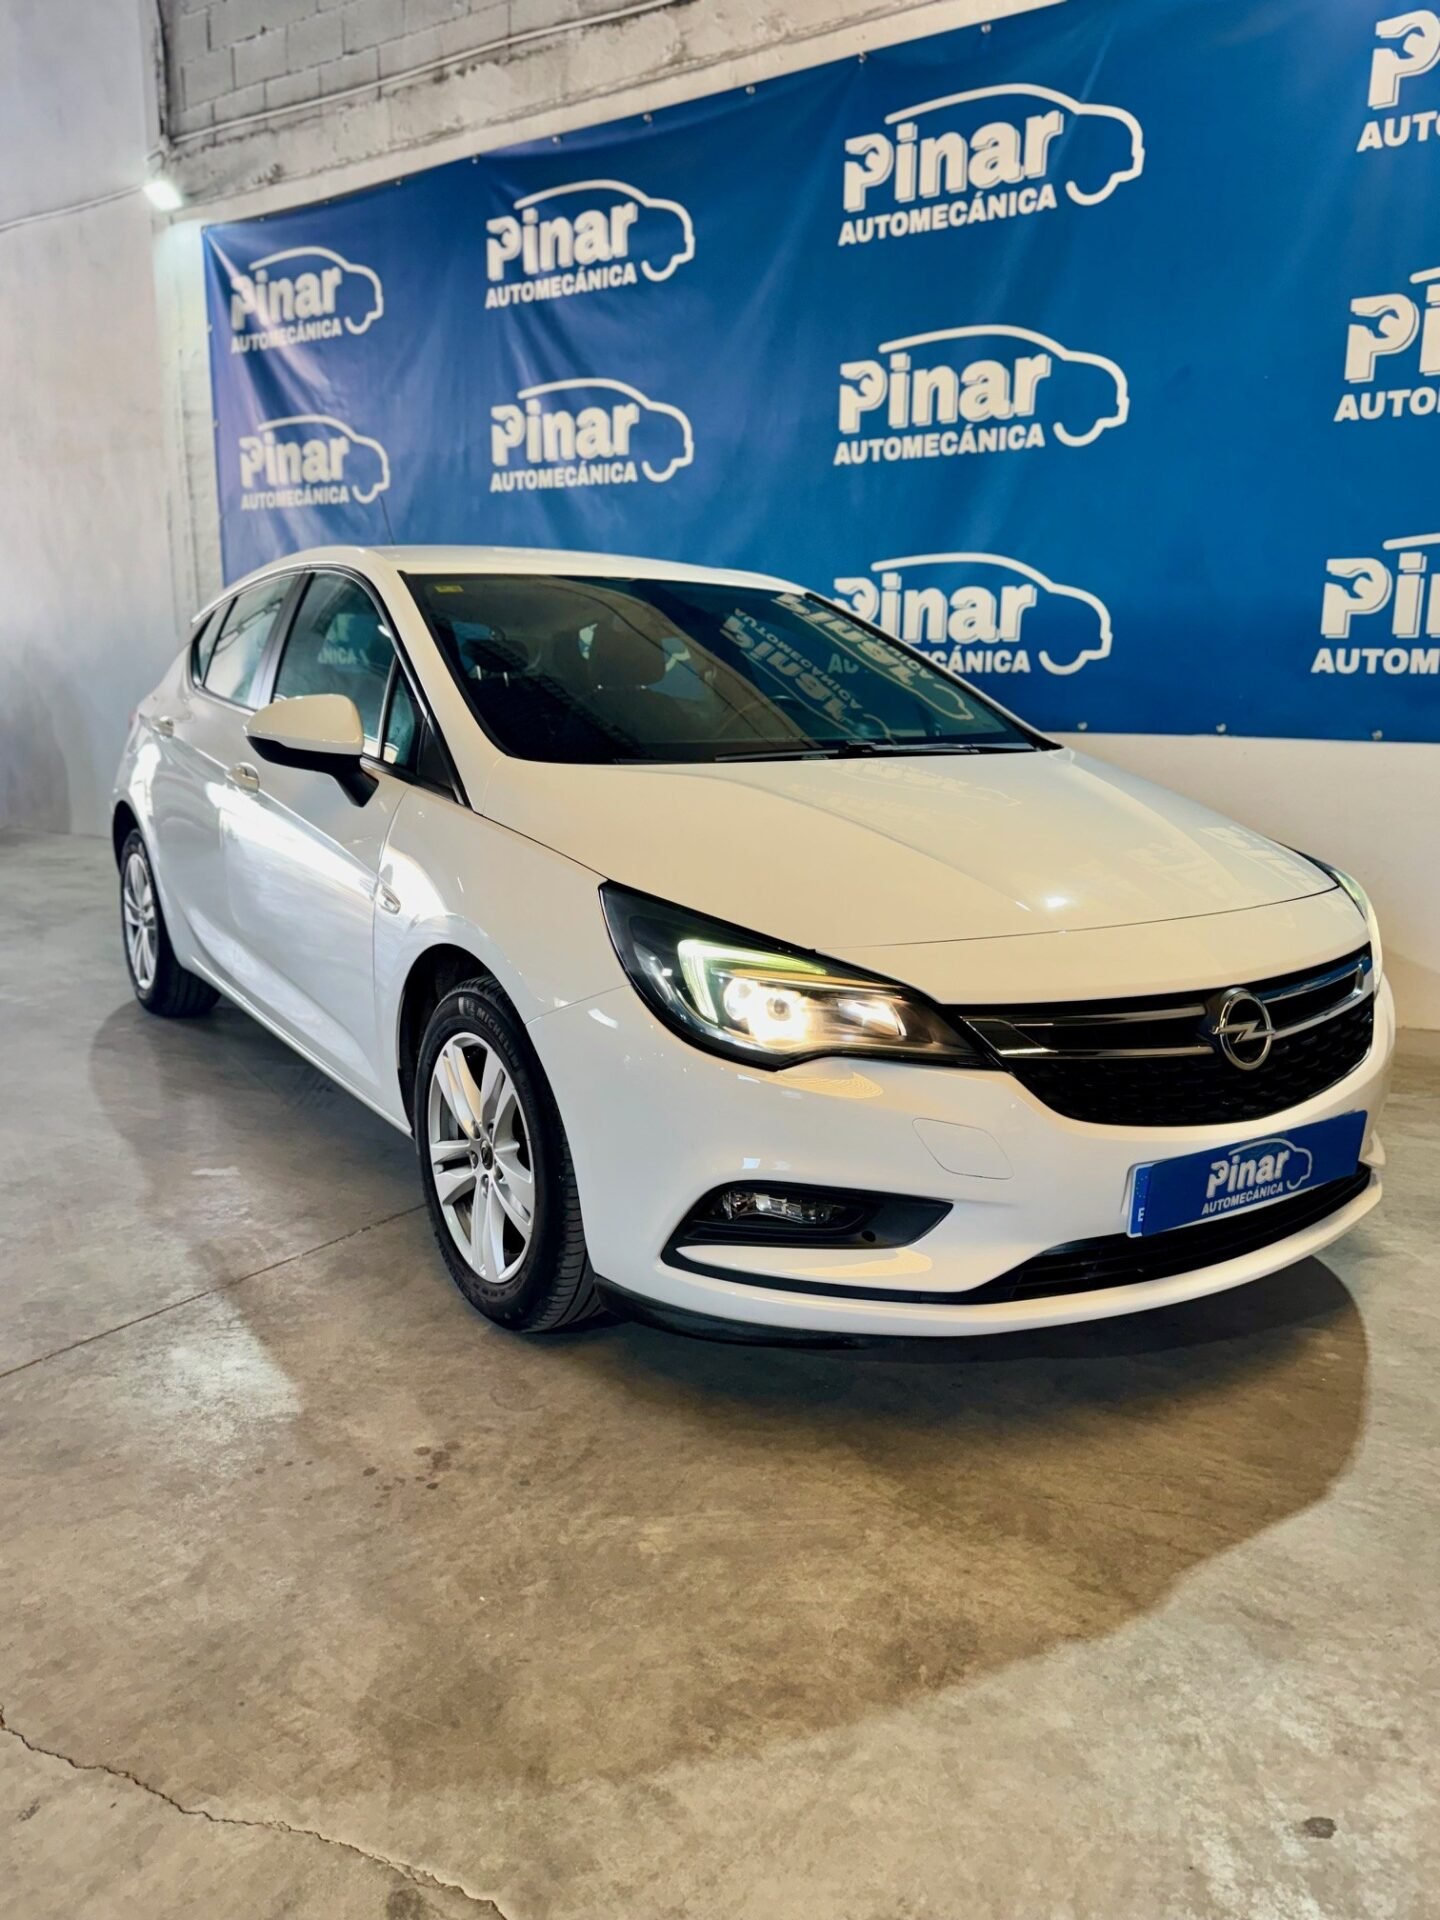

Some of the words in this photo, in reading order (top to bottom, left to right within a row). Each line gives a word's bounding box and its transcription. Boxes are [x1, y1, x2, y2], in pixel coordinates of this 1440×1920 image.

[1367, 9, 1440, 110] P
[1356, 110, 1440, 152] AUT
[843, 109, 1064, 213] Pinar
[486, 201, 639, 281] Pinar
[838, 184, 1058, 246] AUTOMECÁNICA
[231, 266, 342, 331] Pinar
[485, 261, 638, 309] AUTOMECÁNICA
[231, 317, 342, 354] AUTOMECÁNICA
[838, 352, 1051, 434] Pinar
[1333, 386, 1440, 422] AUTO
[239, 429, 350, 488] Pinar
[491, 398, 640, 466] Pinar
[833, 423, 1046, 465] AUTOMECÁNICA
[241, 484, 349, 511] AUTOMECÁNICA
[490, 459, 638, 492] AUTOMECÁNICA
[833, 572, 1037, 644] Pinar
[1201, 1181, 1284, 1215] AUTOMECÁNICA
[1206, 1150, 1290, 1198] Pinar
